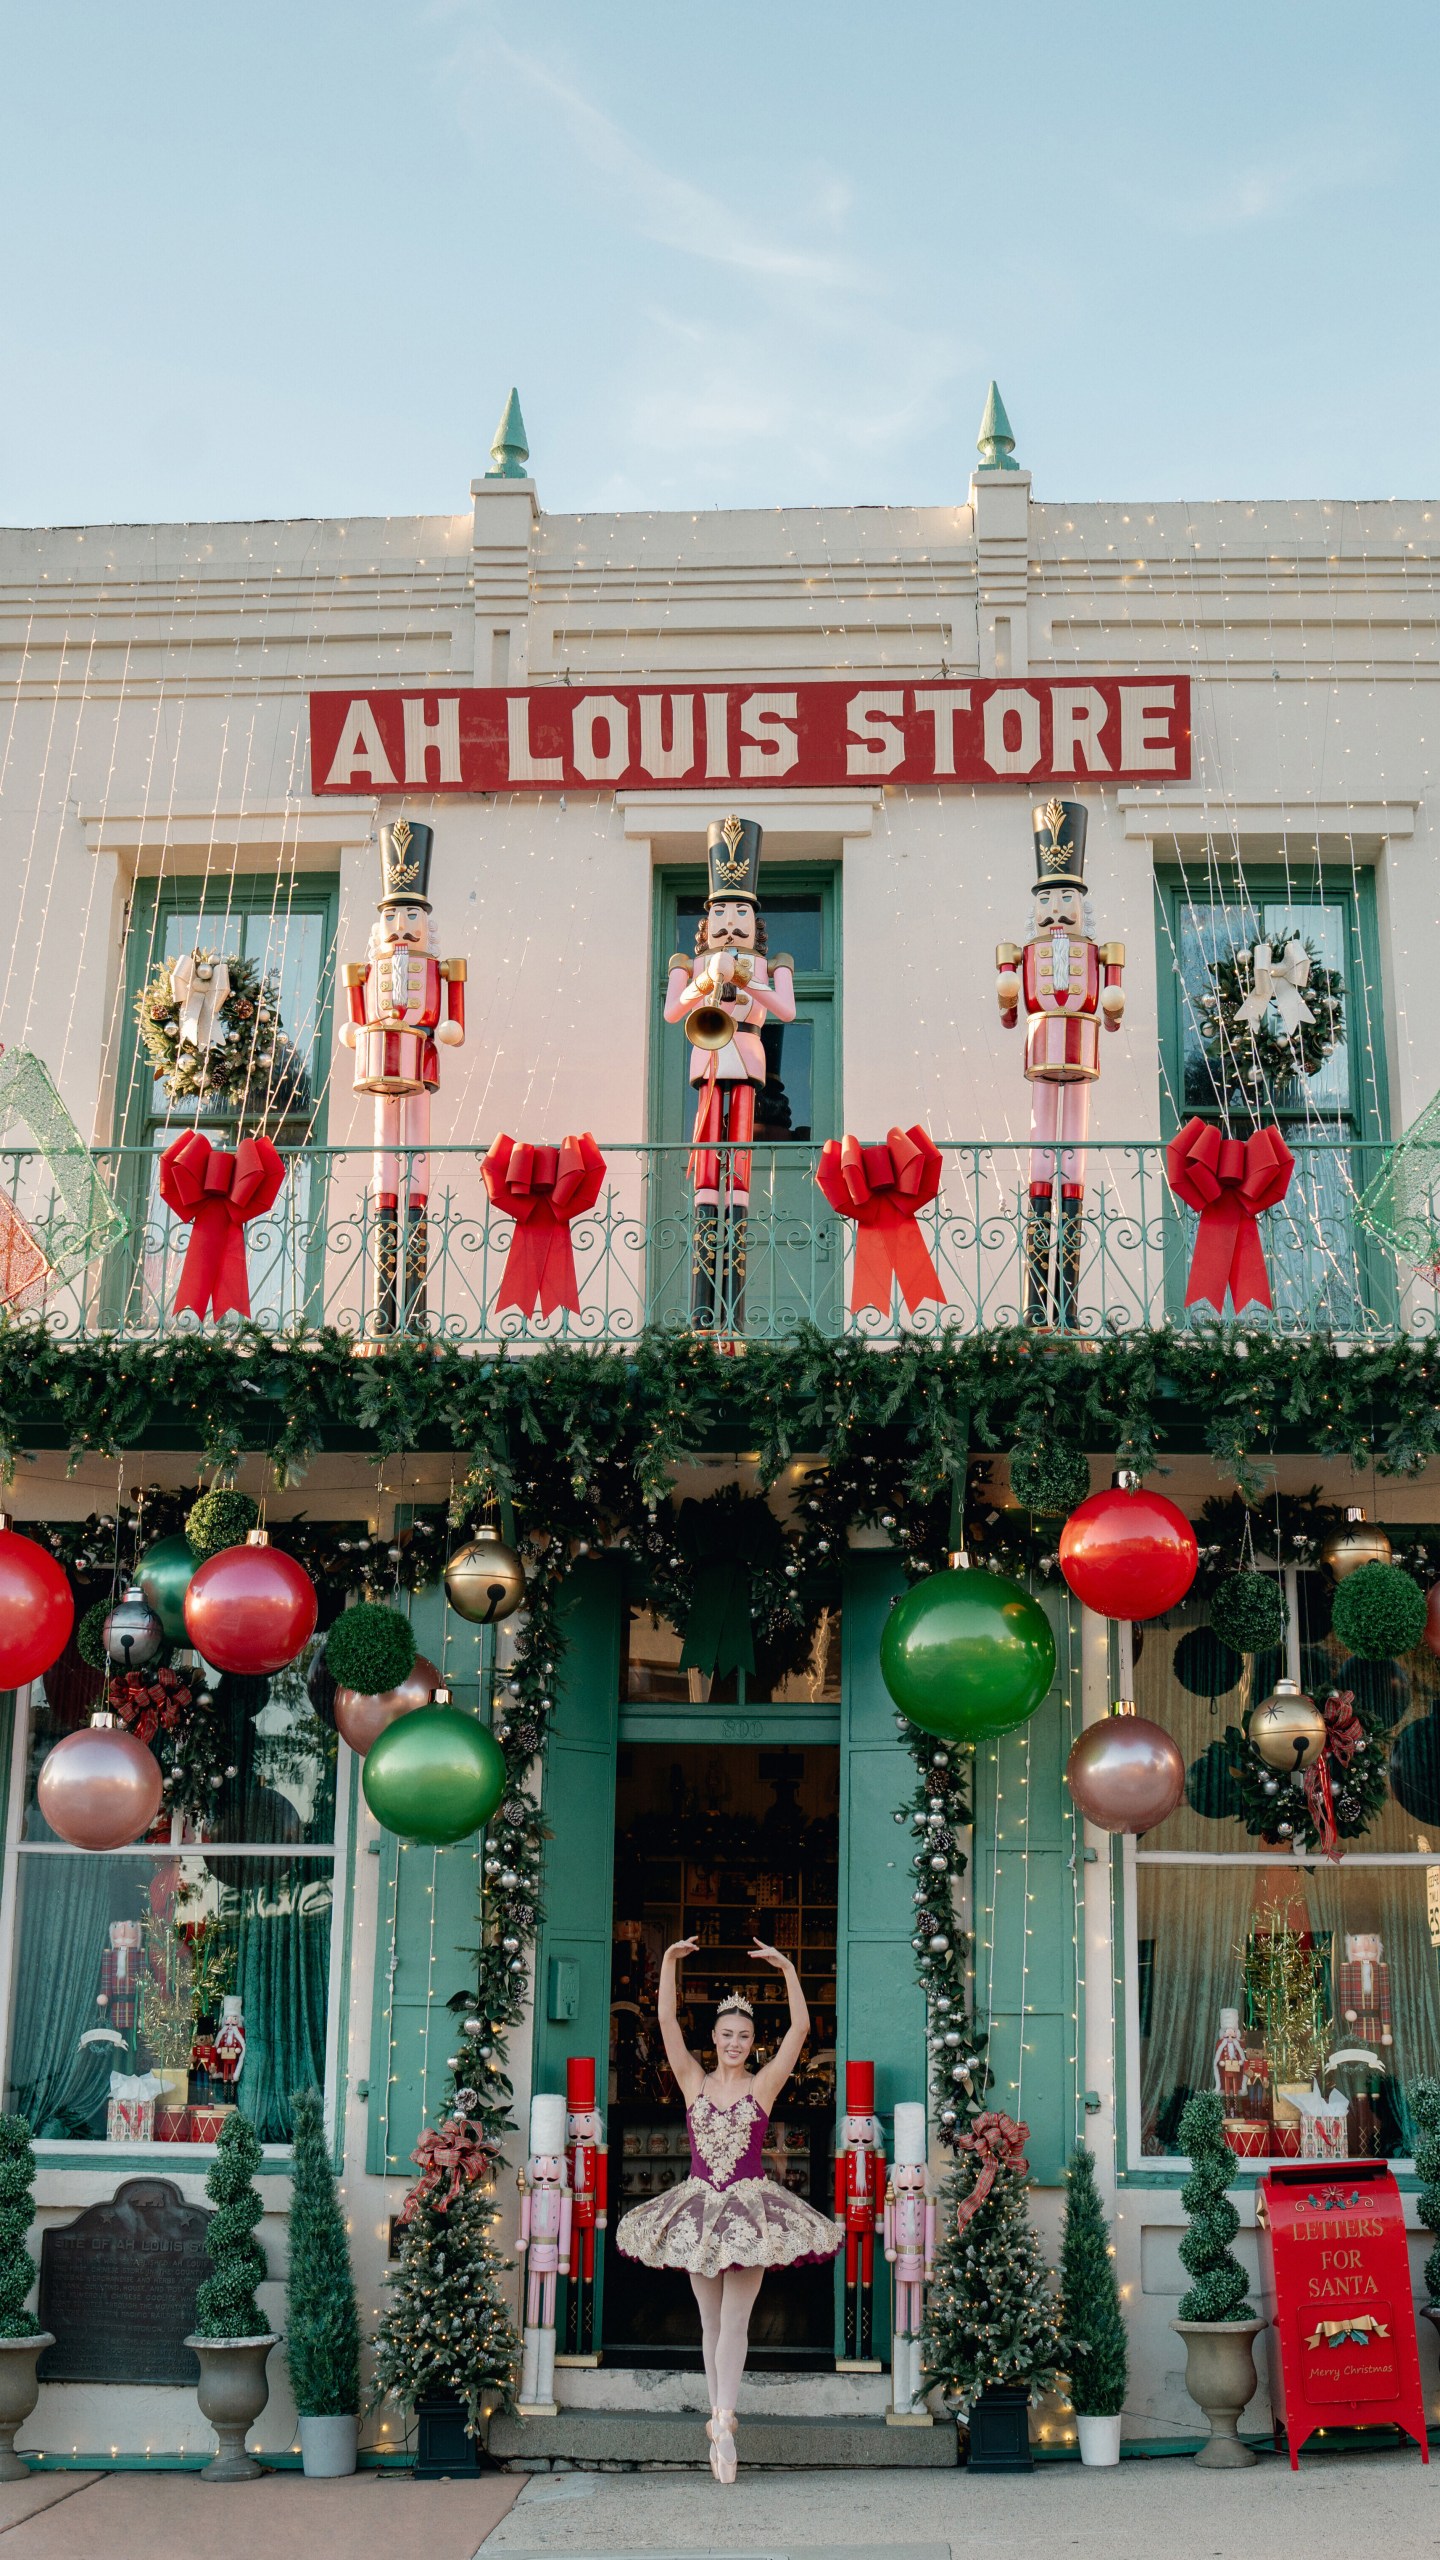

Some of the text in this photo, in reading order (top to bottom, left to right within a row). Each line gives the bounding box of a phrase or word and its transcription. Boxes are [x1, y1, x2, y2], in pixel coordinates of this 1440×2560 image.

[324, 684, 1177, 785] AH LOUIS STORE
[722, 1720, 763, 1739] 800
[1292, 2217, 1384, 2241] LETTERS
[54, 2238, 86, 2249] SITE
[91, 2238, 110, 2250] OF
[117, 2240, 134, 2251] AH
[141, 2240, 183, 2252] LOUIS
[1320, 2249, 1363, 2270] FOR
[1308, 2275, 1379, 2298] SANTA
[1308, 2365, 1393, 2381] Merry Christmas
